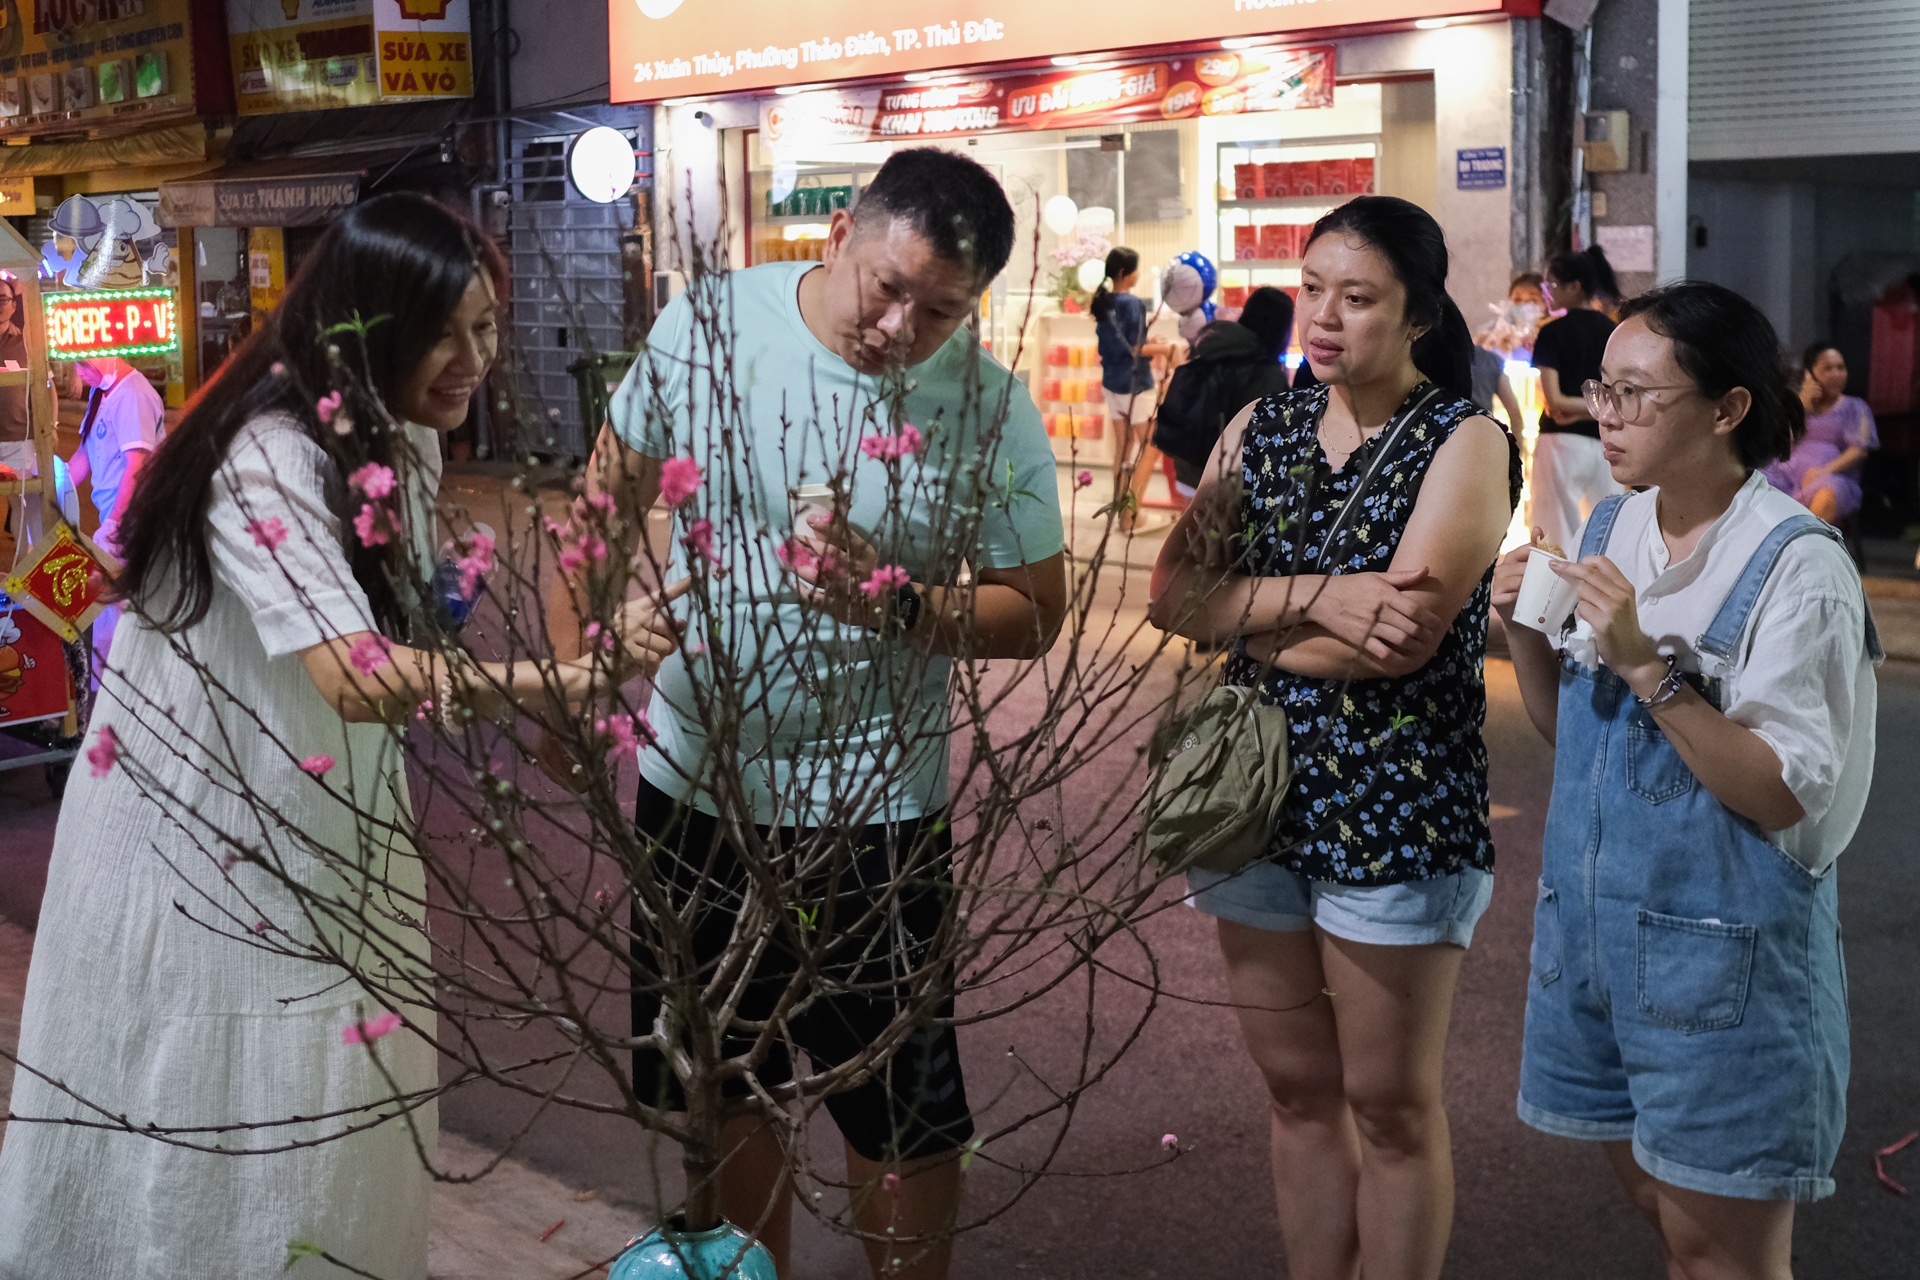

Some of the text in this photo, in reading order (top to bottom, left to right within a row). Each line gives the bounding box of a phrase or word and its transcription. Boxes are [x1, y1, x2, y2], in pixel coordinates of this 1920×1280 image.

[384, 37, 431, 62] SỬA
[439, 42, 466, 62] XE
[654, 58, 691, 80] Xuân
[692, 51, 734, 77] Thủy,
[736, 46, 798, 70] Phường
[800, 37, 842, 62] Thảo
[892, 29, 922, 51] TP.
[923, 20, 960, 47] Thủ
[963, 18, 1004, 43] Đức
[385, 67, 456, 91] VÁ VỎ
[1125, 68, 1157, 97] GIÁ
[258, 186, 306, 208] THANH
